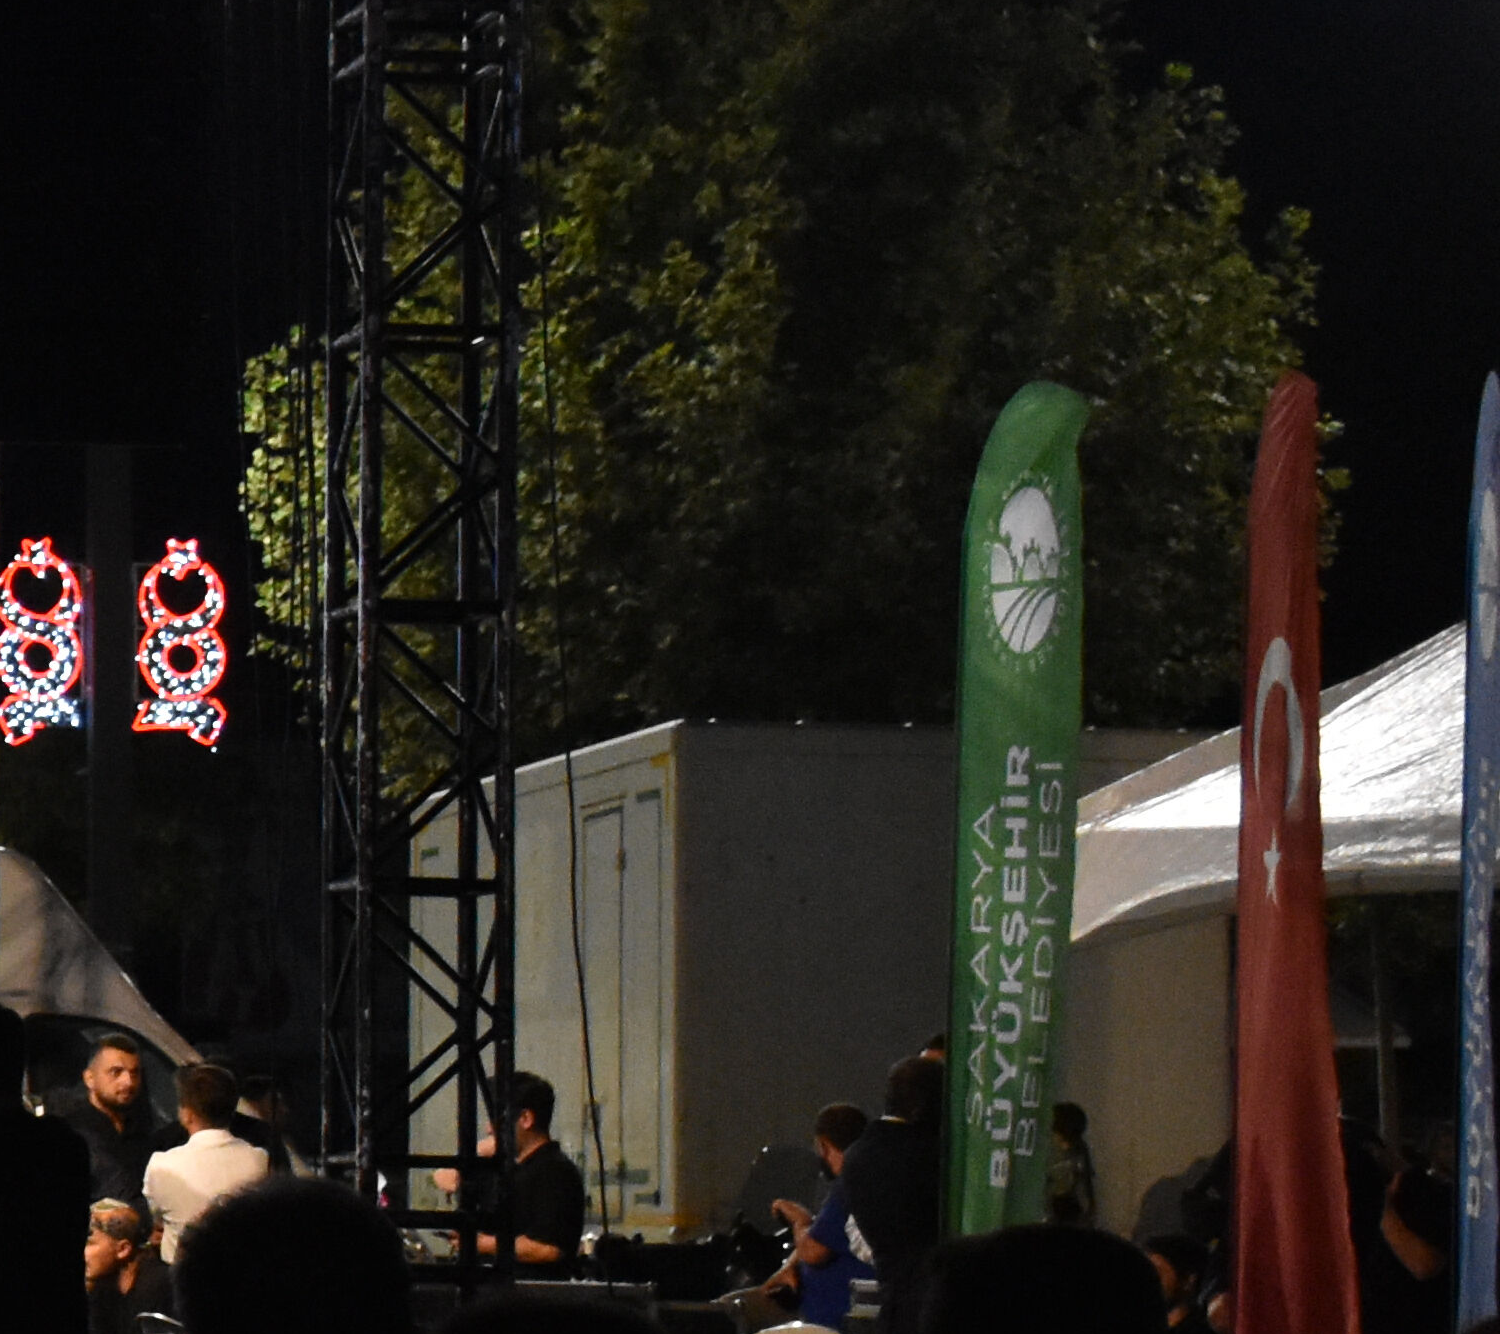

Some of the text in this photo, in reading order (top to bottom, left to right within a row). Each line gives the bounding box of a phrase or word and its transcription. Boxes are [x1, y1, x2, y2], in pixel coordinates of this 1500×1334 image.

[963, 802, 998, 1126] SAKARYA
[984, 743, 1033, 1190] BÜYÜKŞEHİR
[1013, 762, 1064, 1157] BELEDİYESİ
